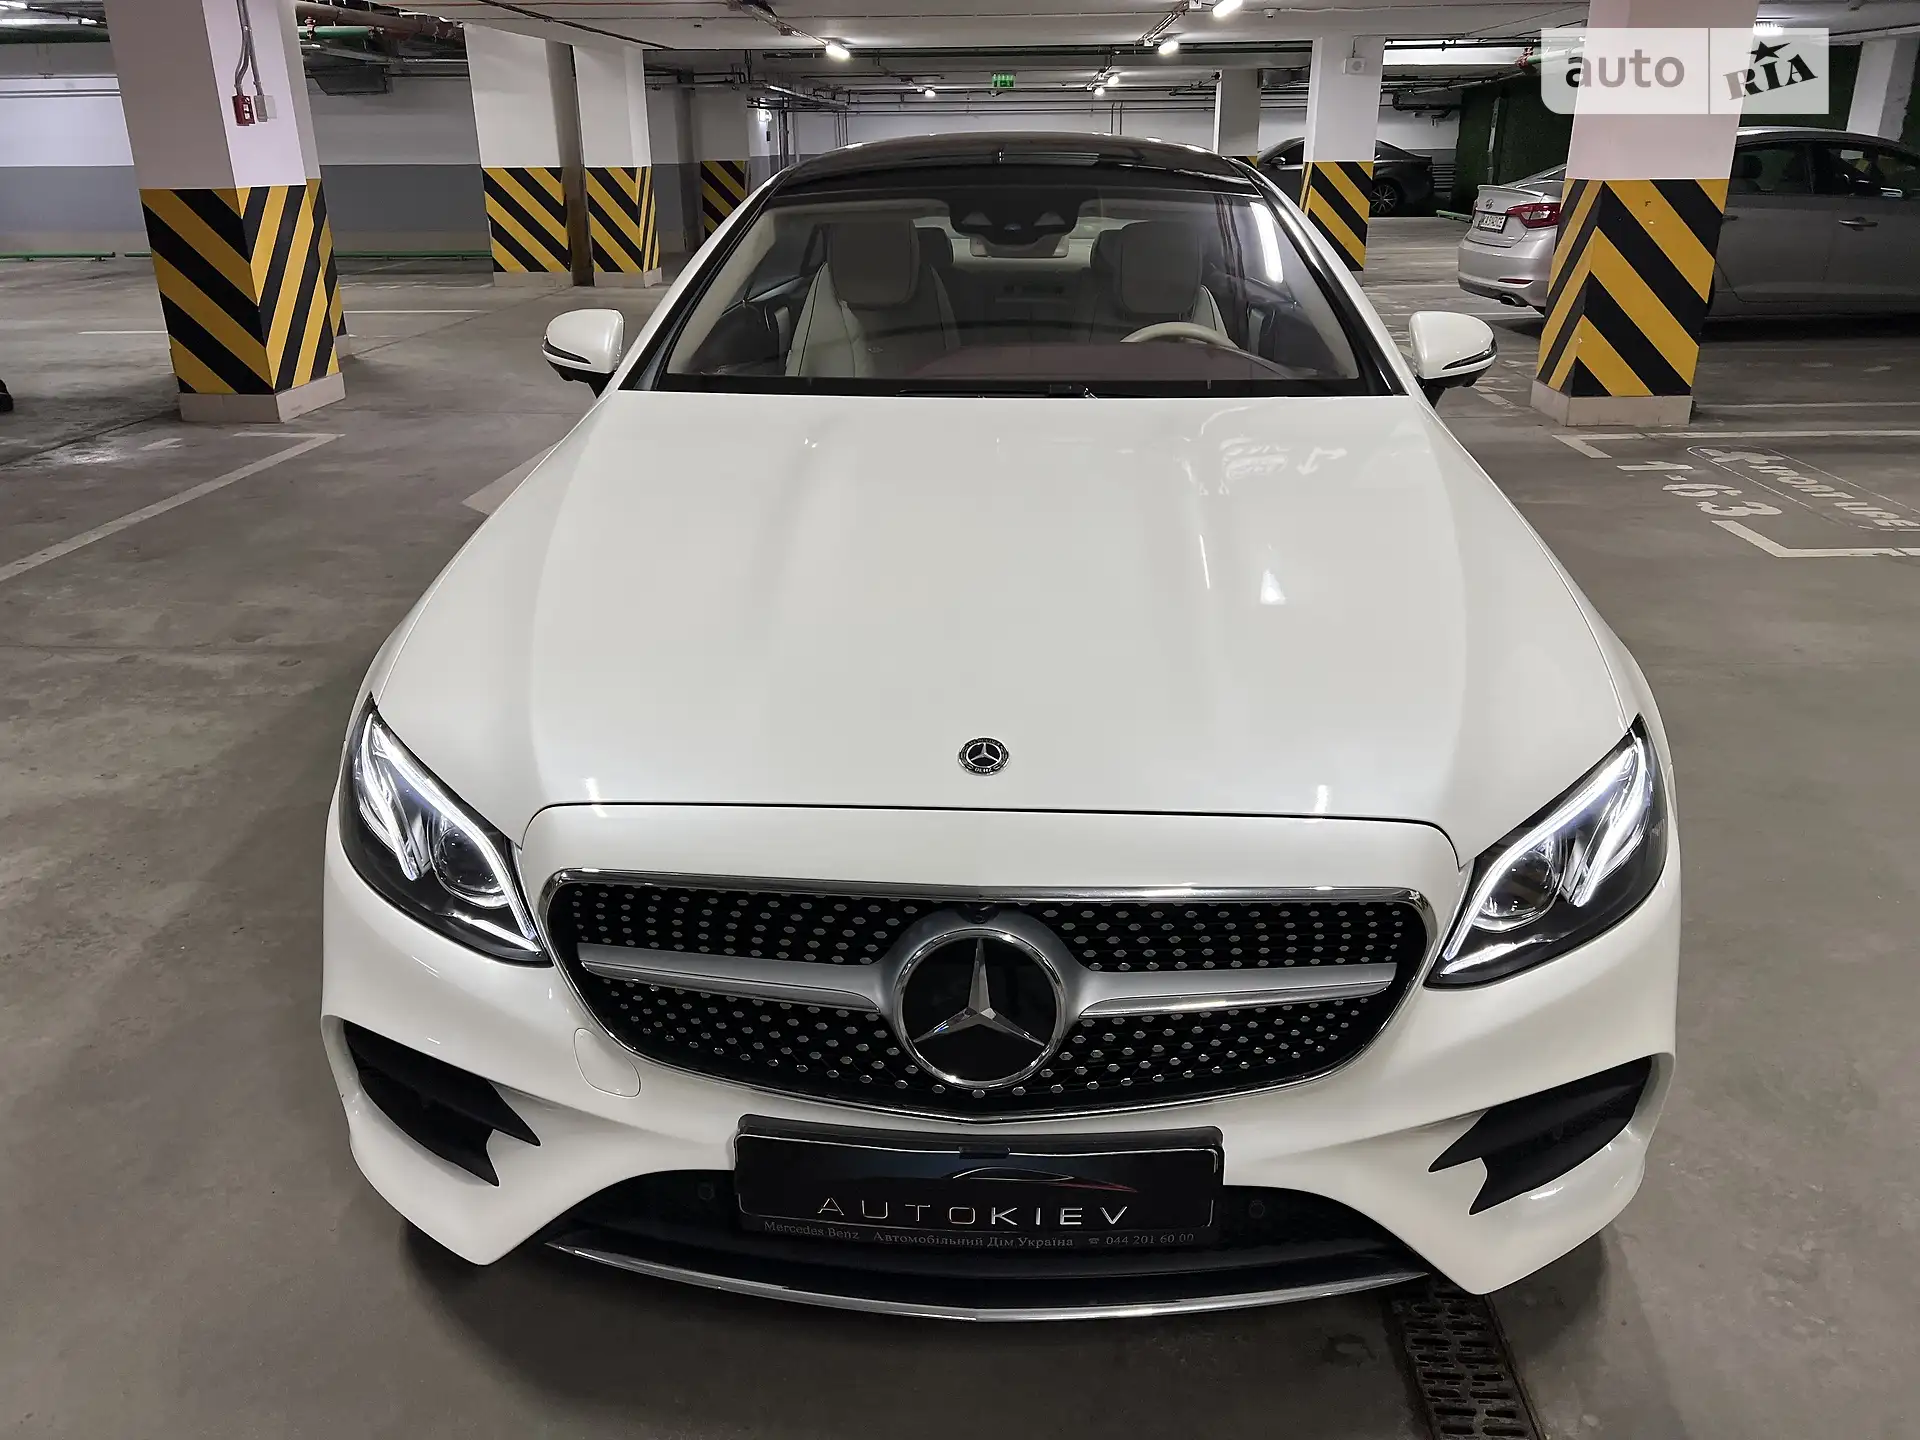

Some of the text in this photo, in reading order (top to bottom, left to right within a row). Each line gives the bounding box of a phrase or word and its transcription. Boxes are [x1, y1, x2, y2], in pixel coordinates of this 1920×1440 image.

[817, 1197, 1128, 1225] AUTOKIEV
[873, 1230, 1073, 1250] Автомобільний Дім Україна
[1106, 1232, 1194, 1246] 044 201 60 00
